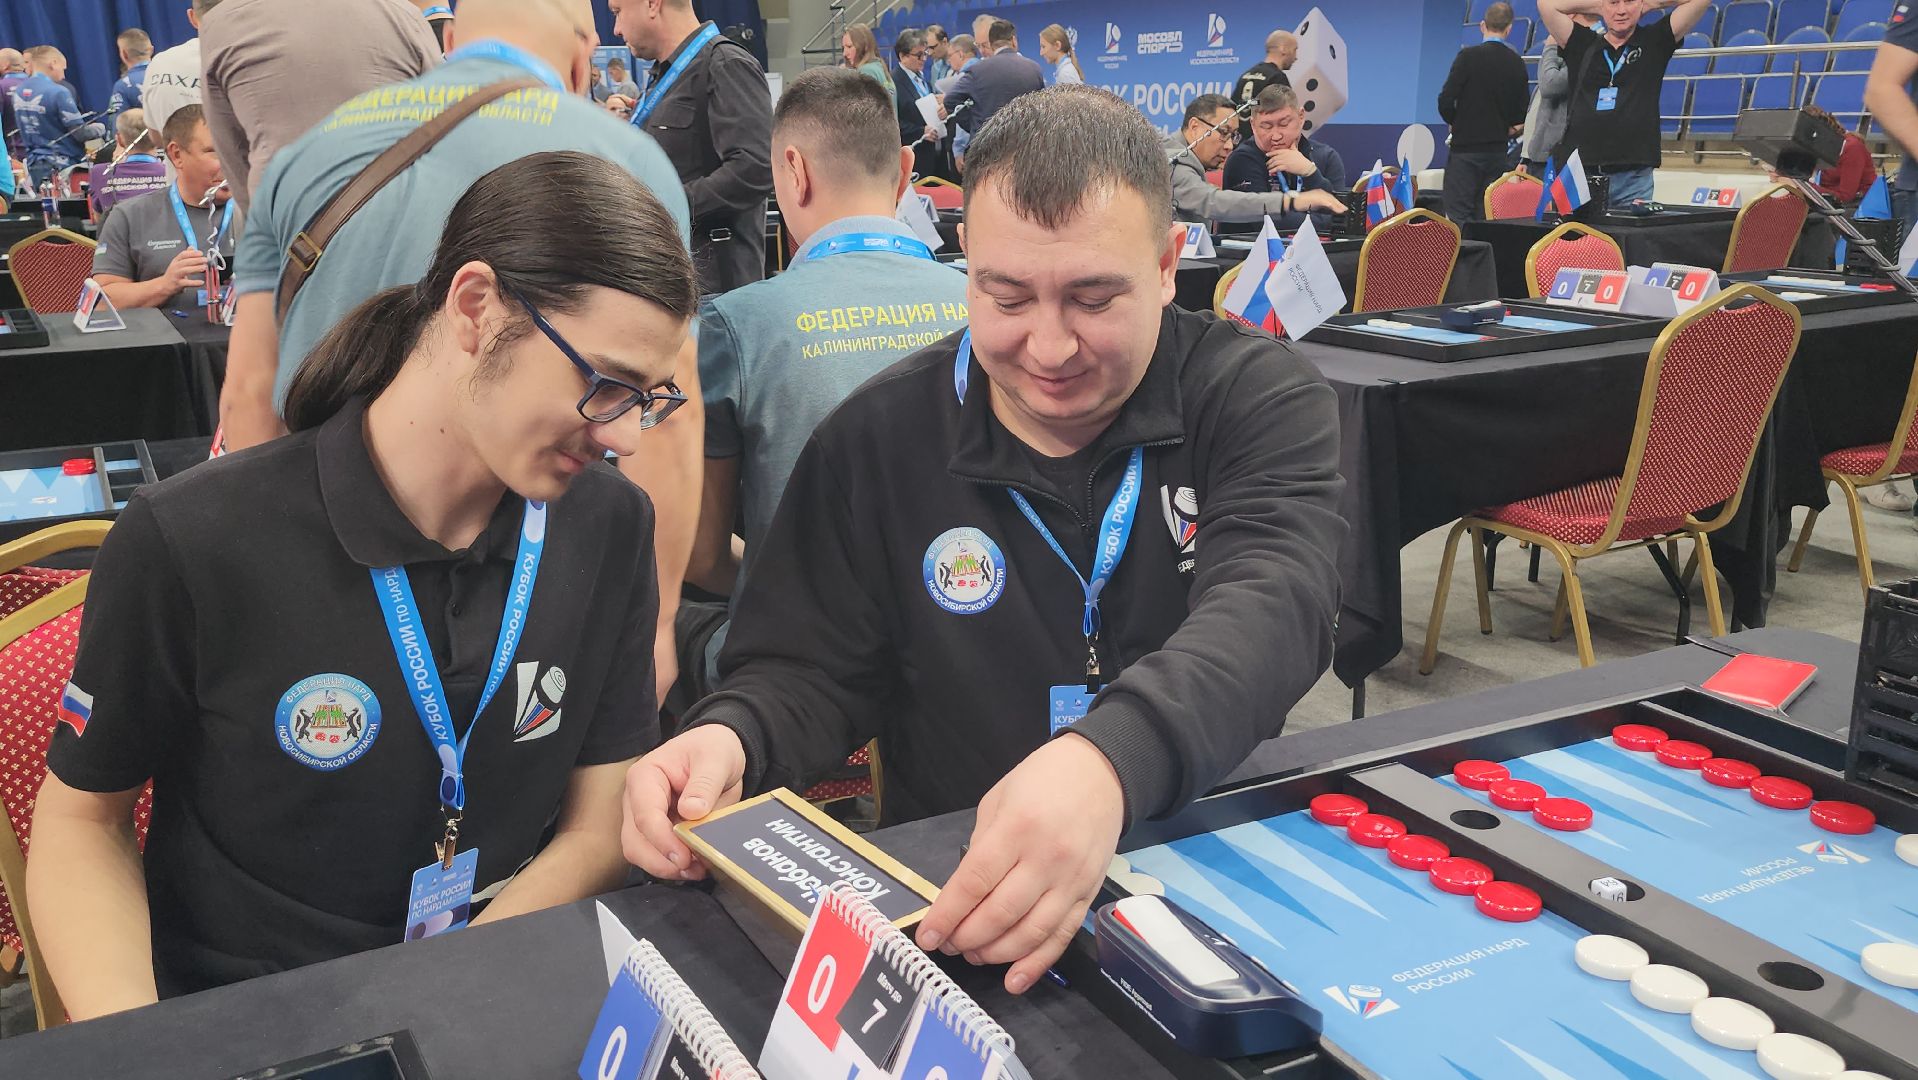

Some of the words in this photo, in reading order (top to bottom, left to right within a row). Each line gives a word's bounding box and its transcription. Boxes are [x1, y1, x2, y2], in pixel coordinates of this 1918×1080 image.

[1557, 281, 1568, 296] 0
[1584, 283, 1591, 292] 7
[1603, 285, 1614, 300] 0
[1671, 279, 1678, 288] 7
[1685, 281, 1696, 296] 0
[796, 303, 937, 332] ФЕДЕРАЦИЯ
[941, 302, 969, 320] НА
[802, 328, 943, 359] КАЛИНИНГРАДСКОЙ
[1013, 490, 1046, 533] ОССИИ
[1101, 526, 1122, 574] КУБОК
[1112, 465, 1137, 524] РОССИИ
[384, 566, 403, 603] НАРД
[515, 552, 536, 607] КУБОК
[927, 579, 988, 612] НОВОСИБИРСКОЙ
[986, 568, 1005, 602] ОБЛАСТИ
[396, 604, 410, 623] ПО
[398, 625, 432, 692] РОССИИ
[497, 609, 522, 673] РОССИИ
[420, 691, 449, 740] КУБОК
[1055, 715, 1086, 724] КУБ
[278, 725, 348, 768] НОВОСИБИРСКОЙ
[347, 723, 379, 760] ОБЛАСТИ
[742, 838, 825, 904] абанов
[765, 818, 891, 901] Константин
[1391, 949, 1486, 983] ФЕДЕРАЦИЯ
[1482, 938, 1530, 955] НАРД
[1407, 968, 1476, 994] РОССИИ
[807, 954, 837, 1014] 0
[877, 971, 895, 996] Матч
[861, 998, 888, 1034] 7
[598, 1025, 628, 1080] 0
